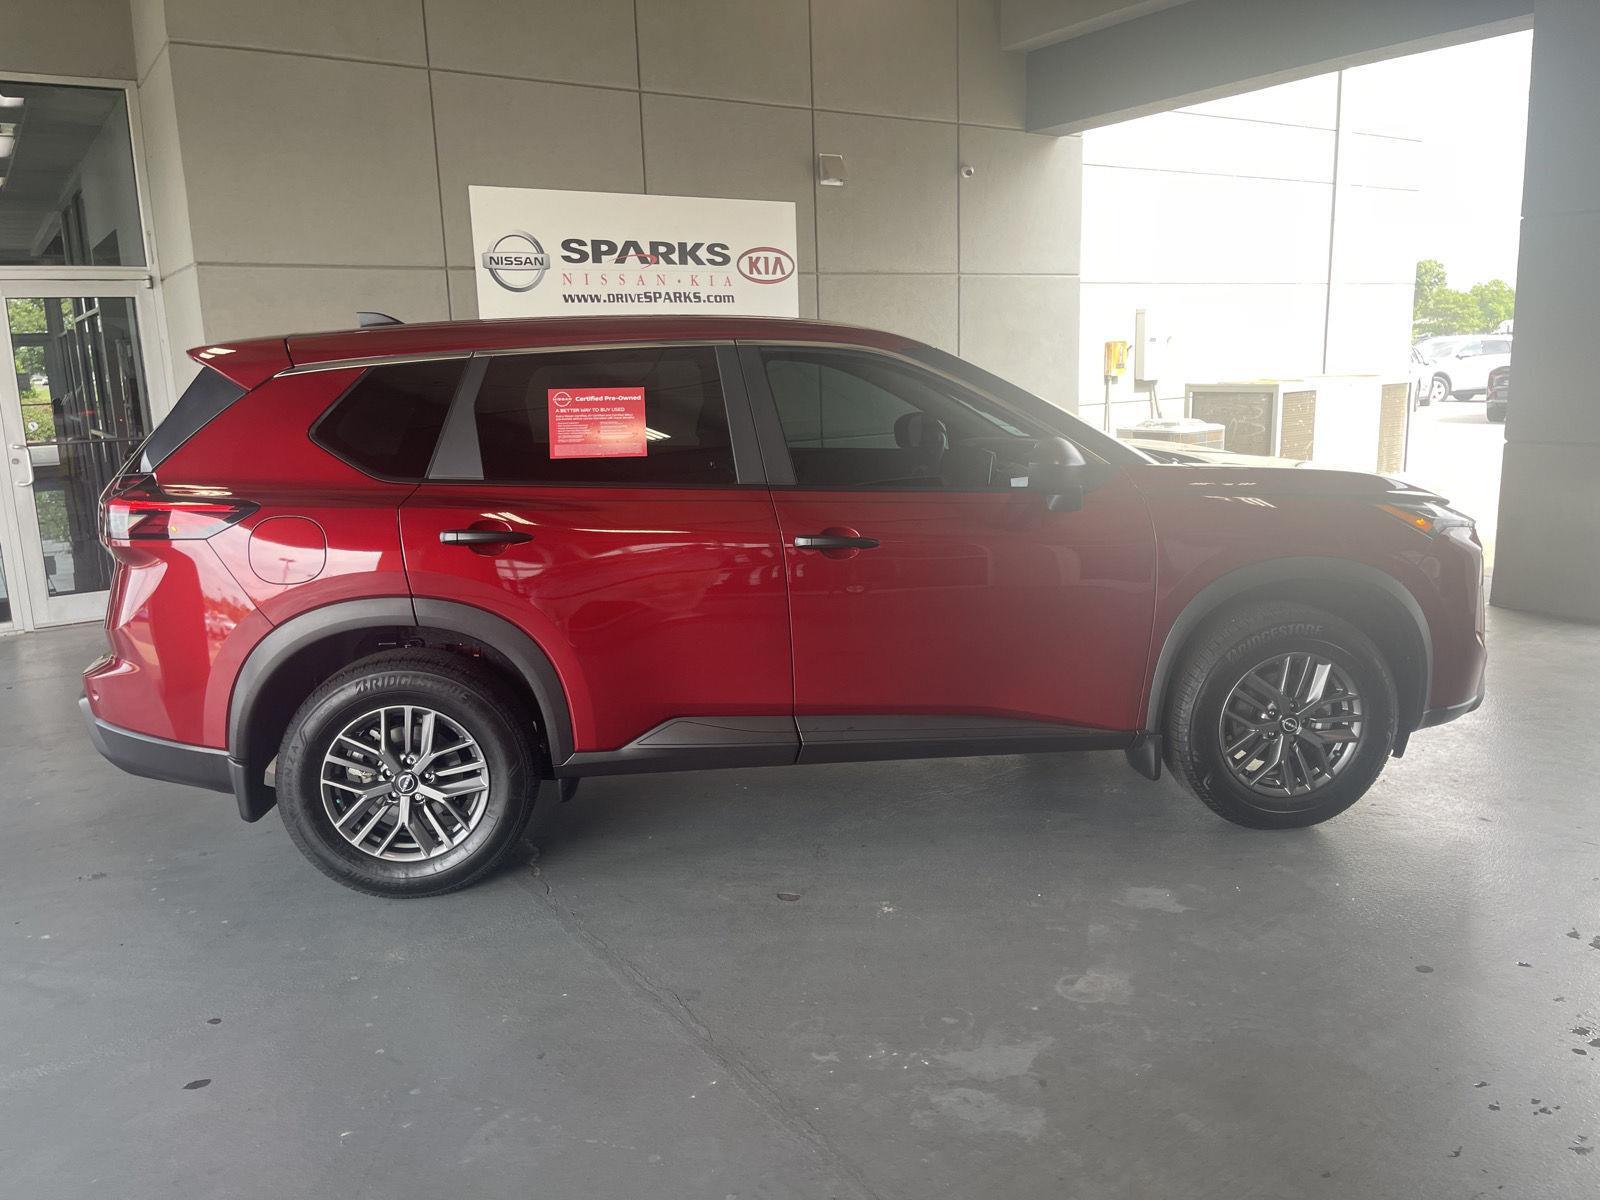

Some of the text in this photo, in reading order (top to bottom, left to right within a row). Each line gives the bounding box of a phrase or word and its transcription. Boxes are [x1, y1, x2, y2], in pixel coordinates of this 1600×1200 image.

[489, 255, 544, 267] NISSAN
[560, 238, 732, 267] SPARKS
[748, 256, 786, 276] KIA
[562, 272, 733, 287] NISSAN KIA
[355, 675, 472, 701] BRIDGEE
